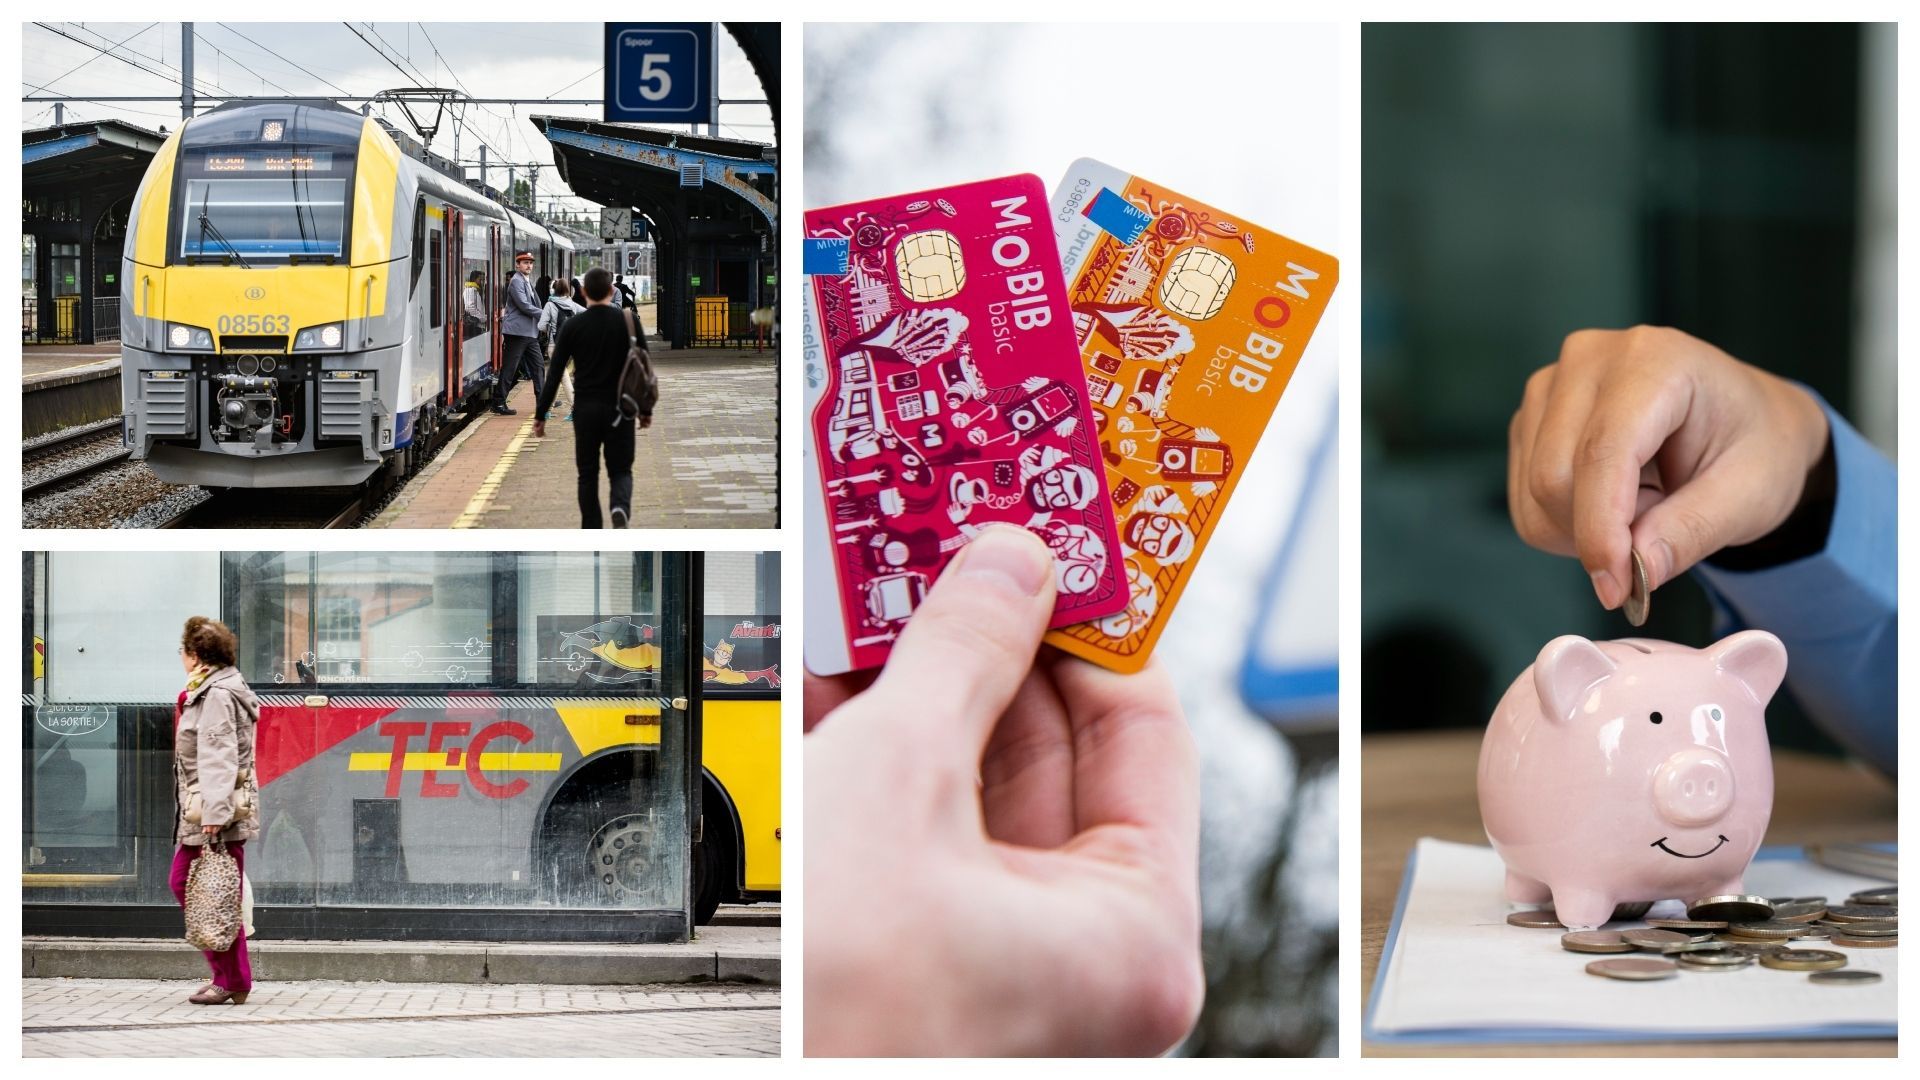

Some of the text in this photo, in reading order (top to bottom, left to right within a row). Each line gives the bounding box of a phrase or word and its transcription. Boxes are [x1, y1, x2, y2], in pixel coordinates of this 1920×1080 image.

[624, 36, 655, 49] Spoor
[638, 53, 672, 101] 5
[1057, 177, 1091, 223] 639653
[1122, 204, 1151, 222] MIVB
[631, 221, 641, 237] 5
[816, 238, 847, 250] MIVB
[1126, 223, 1144, 244] STIB
[990, 195, 1052, 331] MOBIB
[217, 314, 290, 335] 08563
[988, 300, 1017, 355] basic
[1228, 261, 1320, 393] MOBIB
[1196, 344, 1239, 397] basic
[48, 716, 59, 727] LA
[379, 721, 535, 799] TEC
